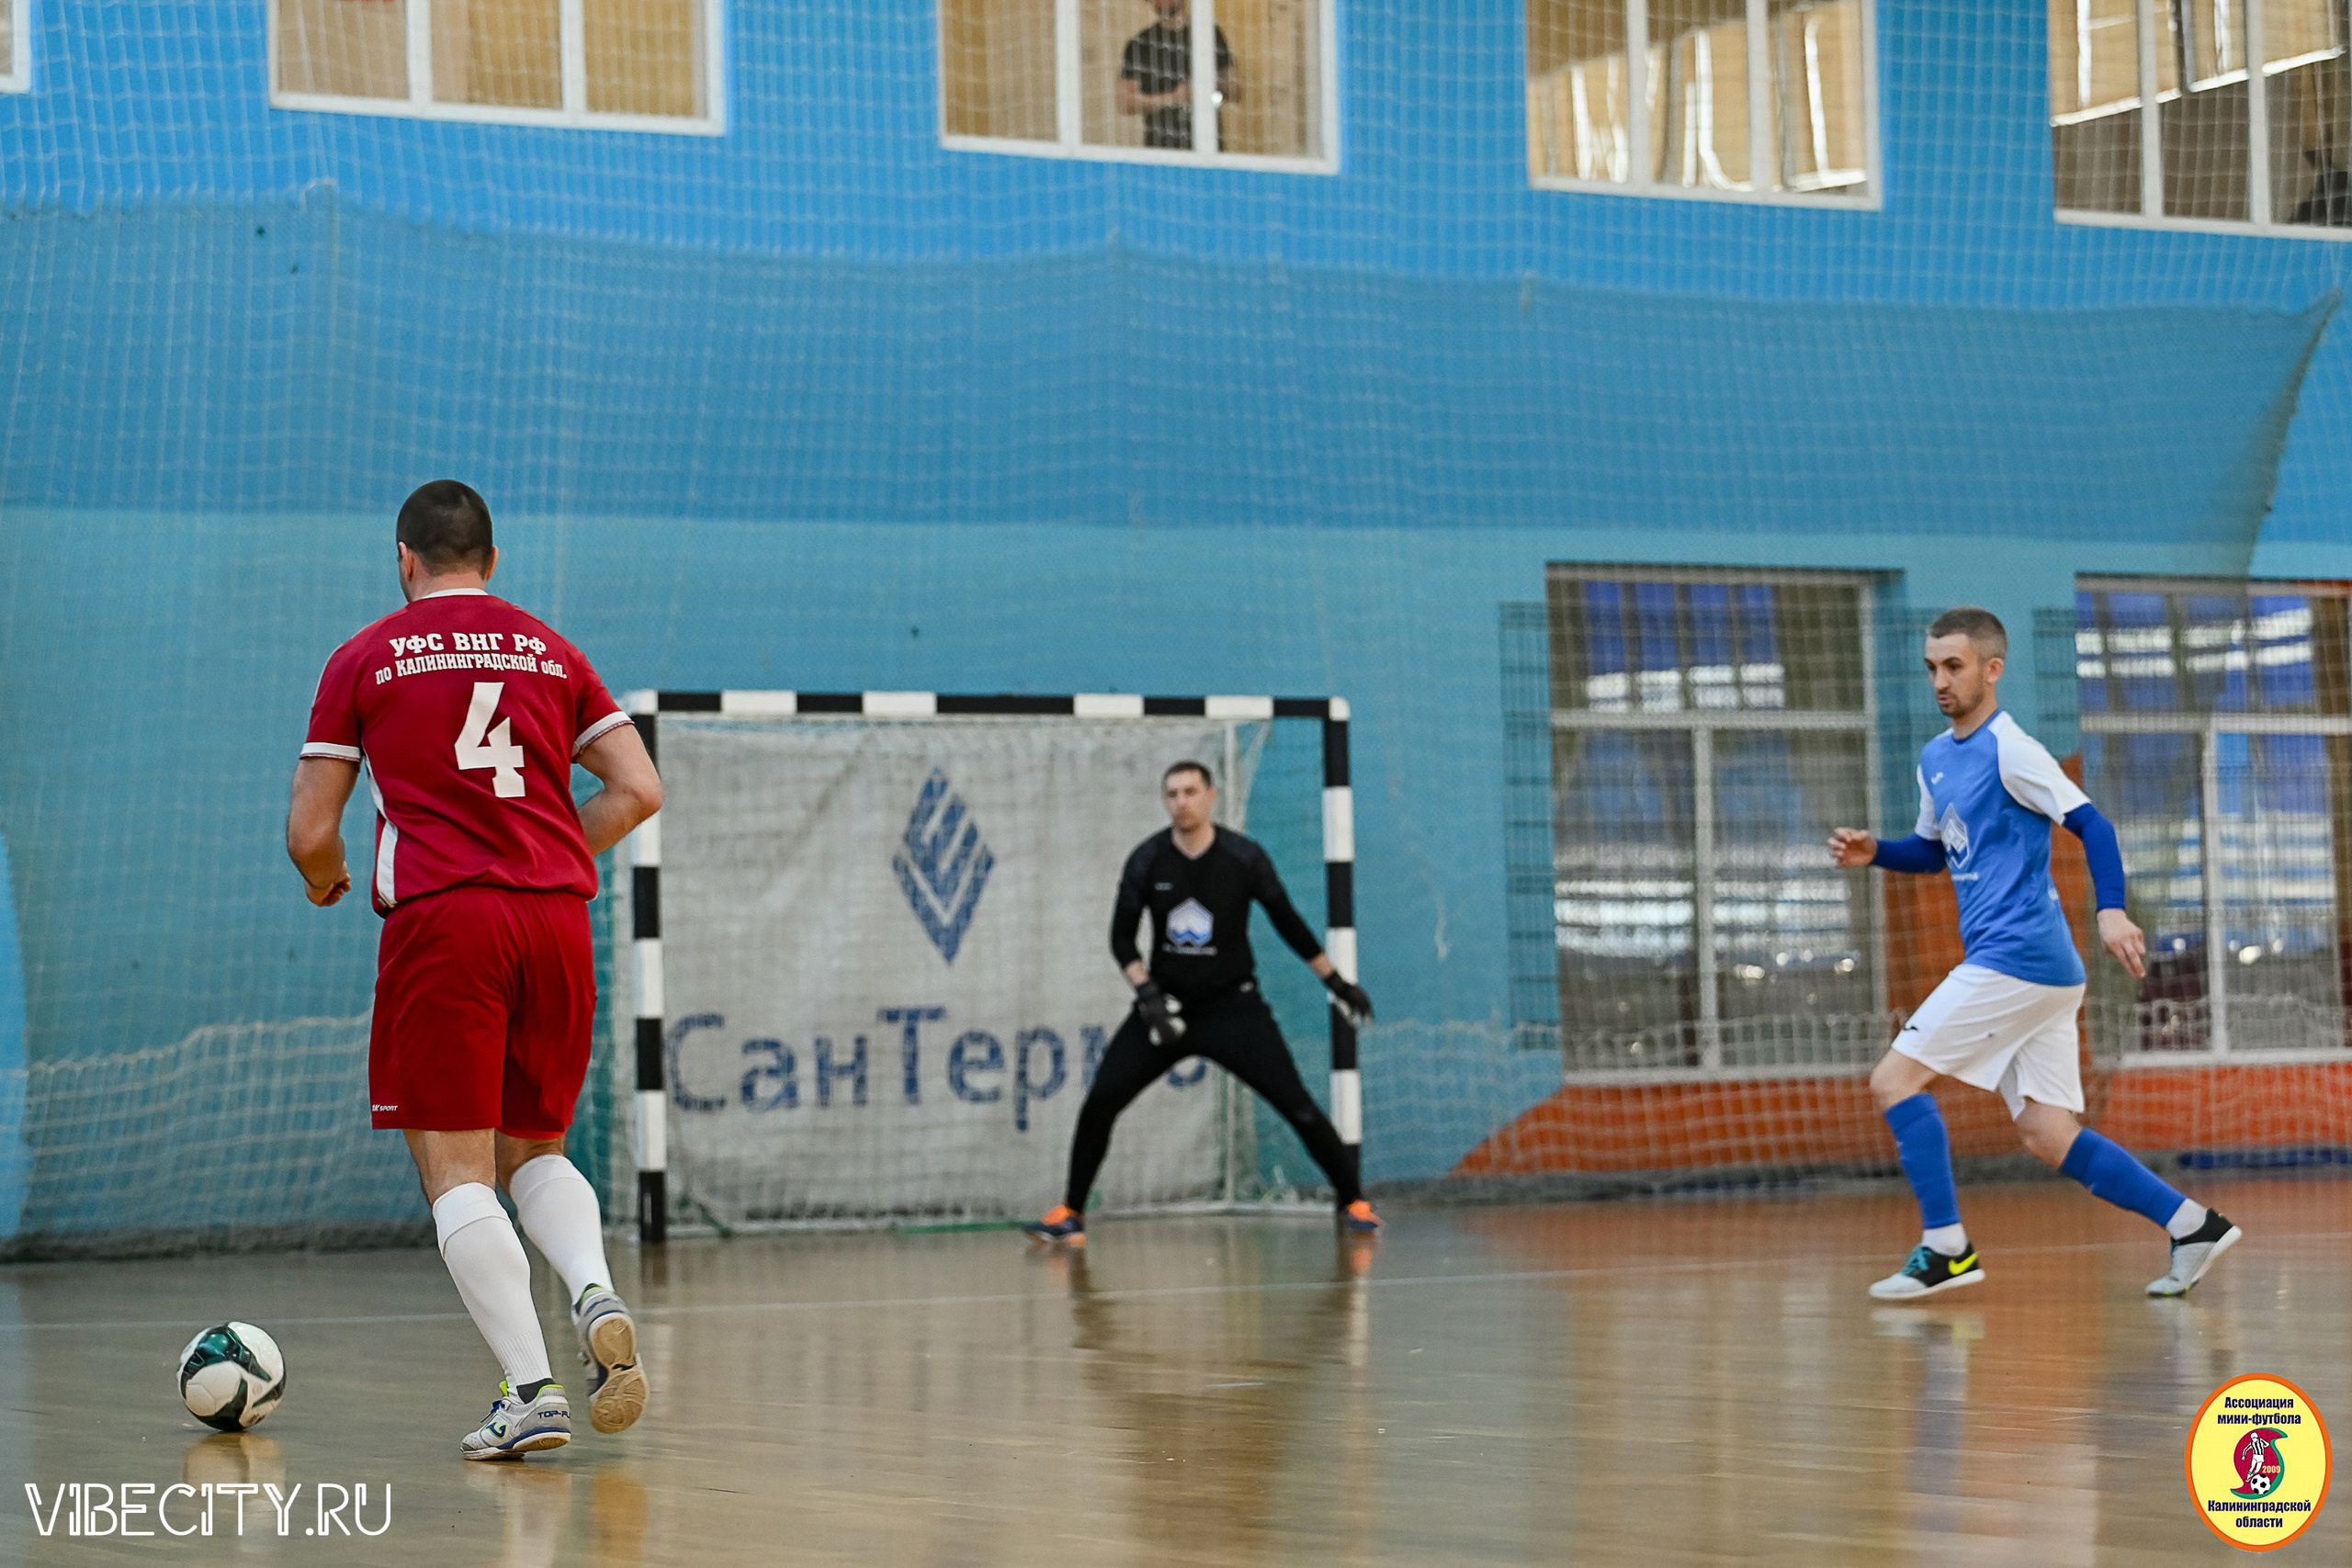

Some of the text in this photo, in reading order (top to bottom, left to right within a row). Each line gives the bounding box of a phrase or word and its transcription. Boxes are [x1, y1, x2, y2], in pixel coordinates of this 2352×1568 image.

[389, 632, 547, 657] УФС ВНГ РФ
[395, 653, 538, 677] КАЛИНИНГРАДСКОЙ
[454, 682, 526, 798] 4
